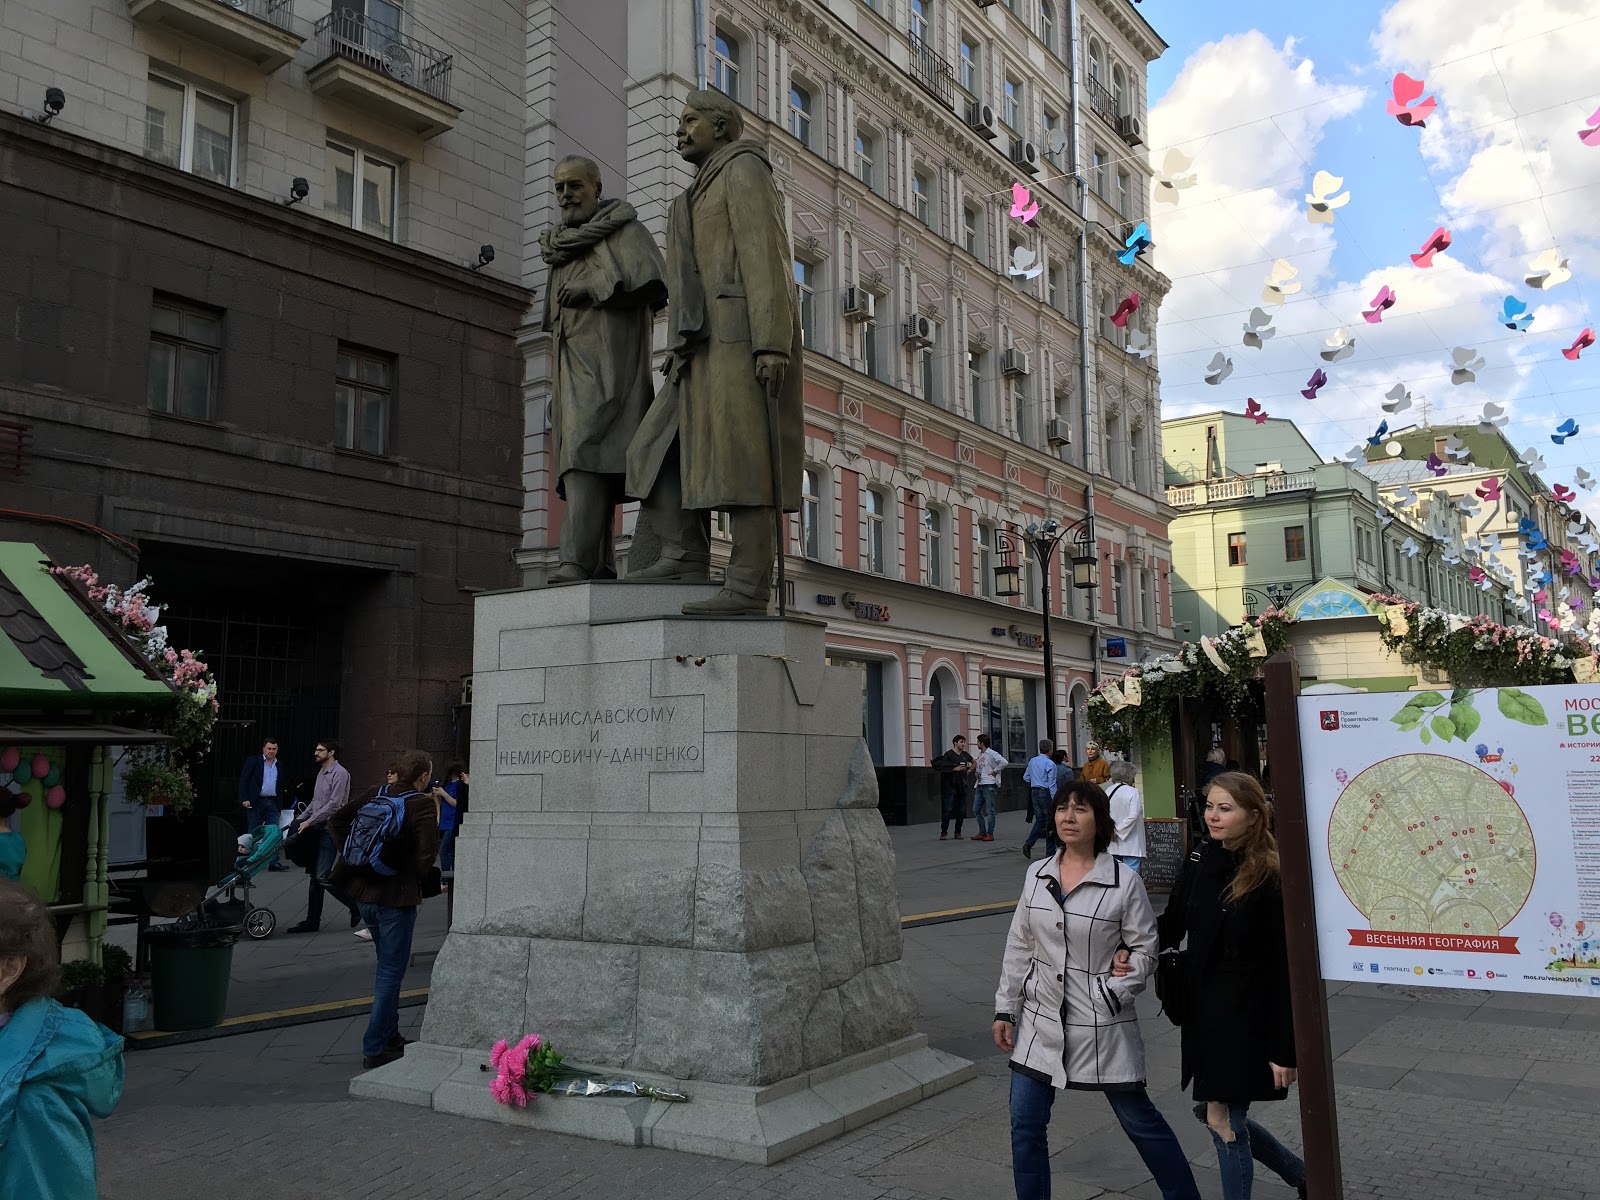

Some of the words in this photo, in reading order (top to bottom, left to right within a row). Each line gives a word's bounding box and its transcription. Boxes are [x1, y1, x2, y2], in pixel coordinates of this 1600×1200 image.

[856, 601, 891, 622] ВТБ24
[1108, 646, 1121, 656] 24
[520, 706, 676, 728] СТАНИСЛАВСКОМУ
[590, 729, 599, 743] И
[499, 745, 700, 765] НЕМИРОВИЧУ-ДАНЧЕНКО
[1366, 933, 1426, 946] ВЕСЕННЯЯ
[1429, 937, 1499, 950] ГЕОГРАФИЯ
[1523, 974, 1583, 983] mos.ru/vesna2016
